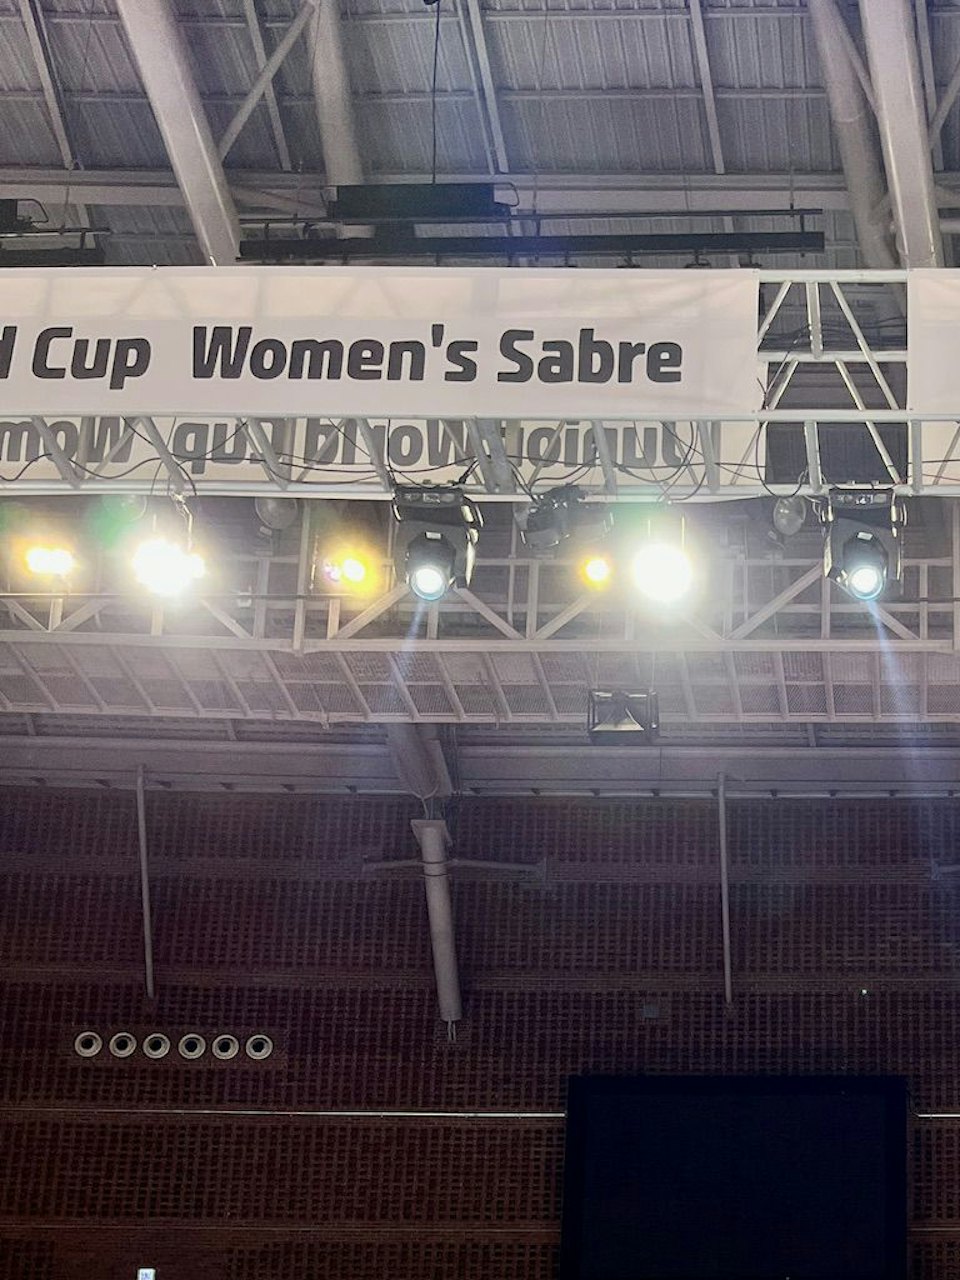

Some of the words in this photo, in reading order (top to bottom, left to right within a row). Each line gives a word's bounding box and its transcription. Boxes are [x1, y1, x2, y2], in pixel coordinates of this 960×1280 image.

[32, 326, 151, 390] Cup
[192, 324, 477, 382] Women's
[497, 328, 682, 383] Sabre
